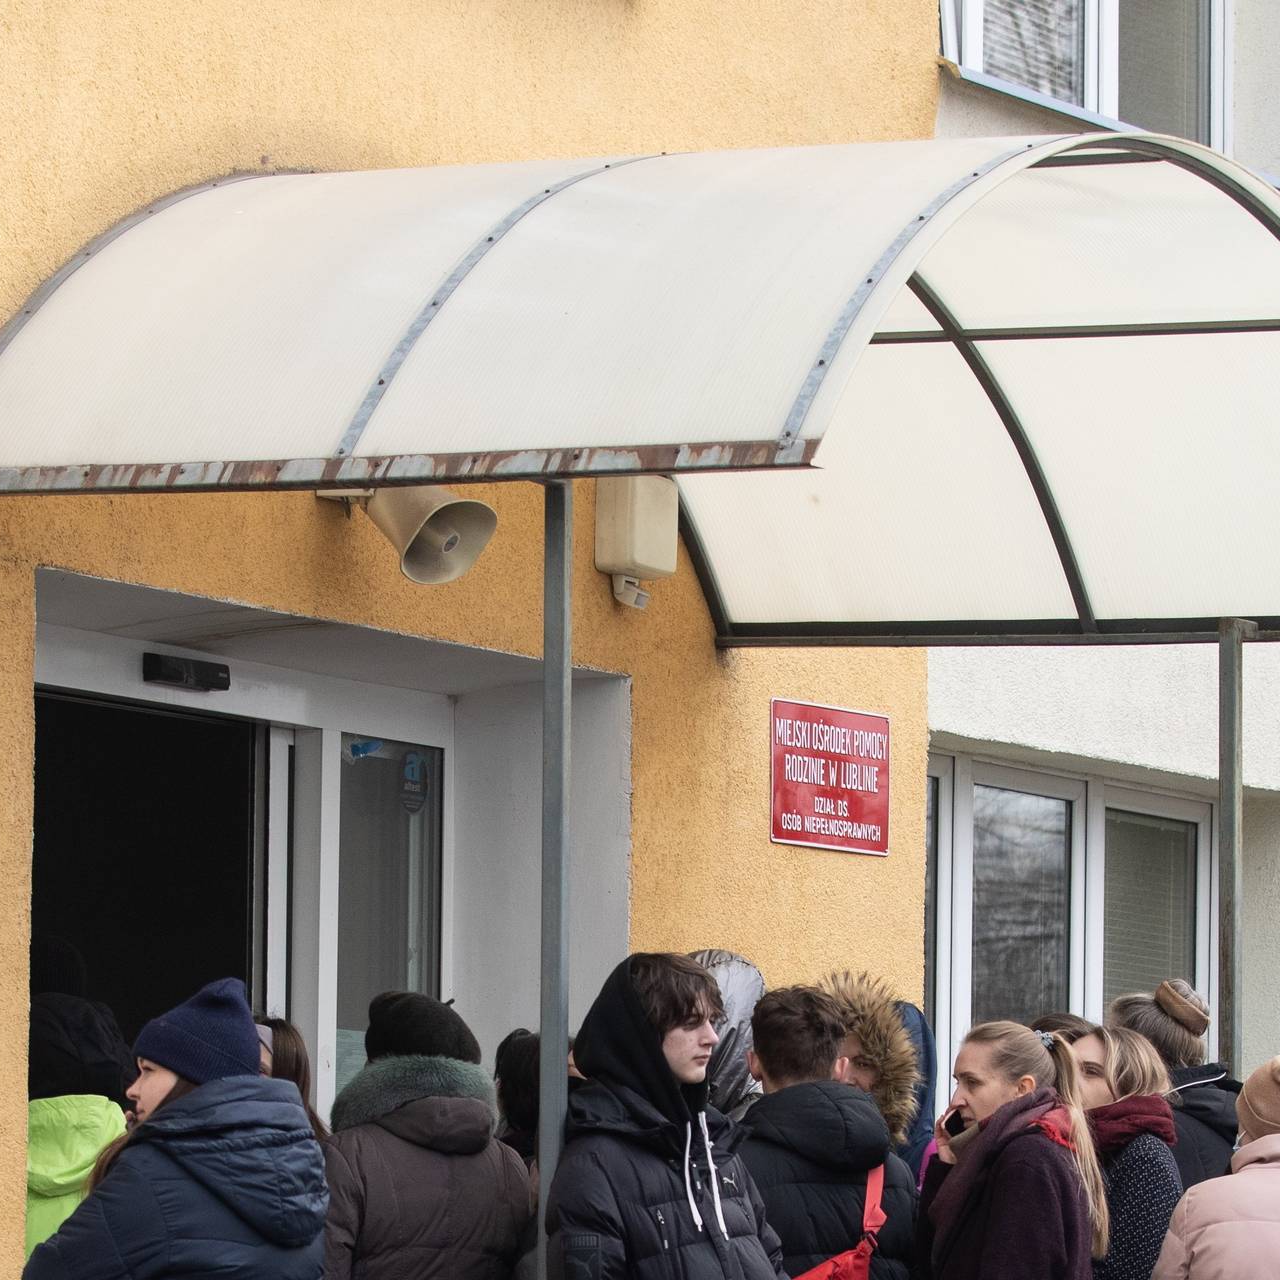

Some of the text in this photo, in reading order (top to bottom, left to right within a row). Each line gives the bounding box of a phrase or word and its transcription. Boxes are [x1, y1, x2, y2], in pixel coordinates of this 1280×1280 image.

[775, 717, 888, 761] MIEJSKI OŚRODEK POMOCY
[784, 753, 879, 793] RODZINIE W LUBLINIE
[814, 796, 850, 817] DZIAŁ DS.
[781, 809, 881, 842] OSÓB NIEPEŁNOSPRAWNYCH
